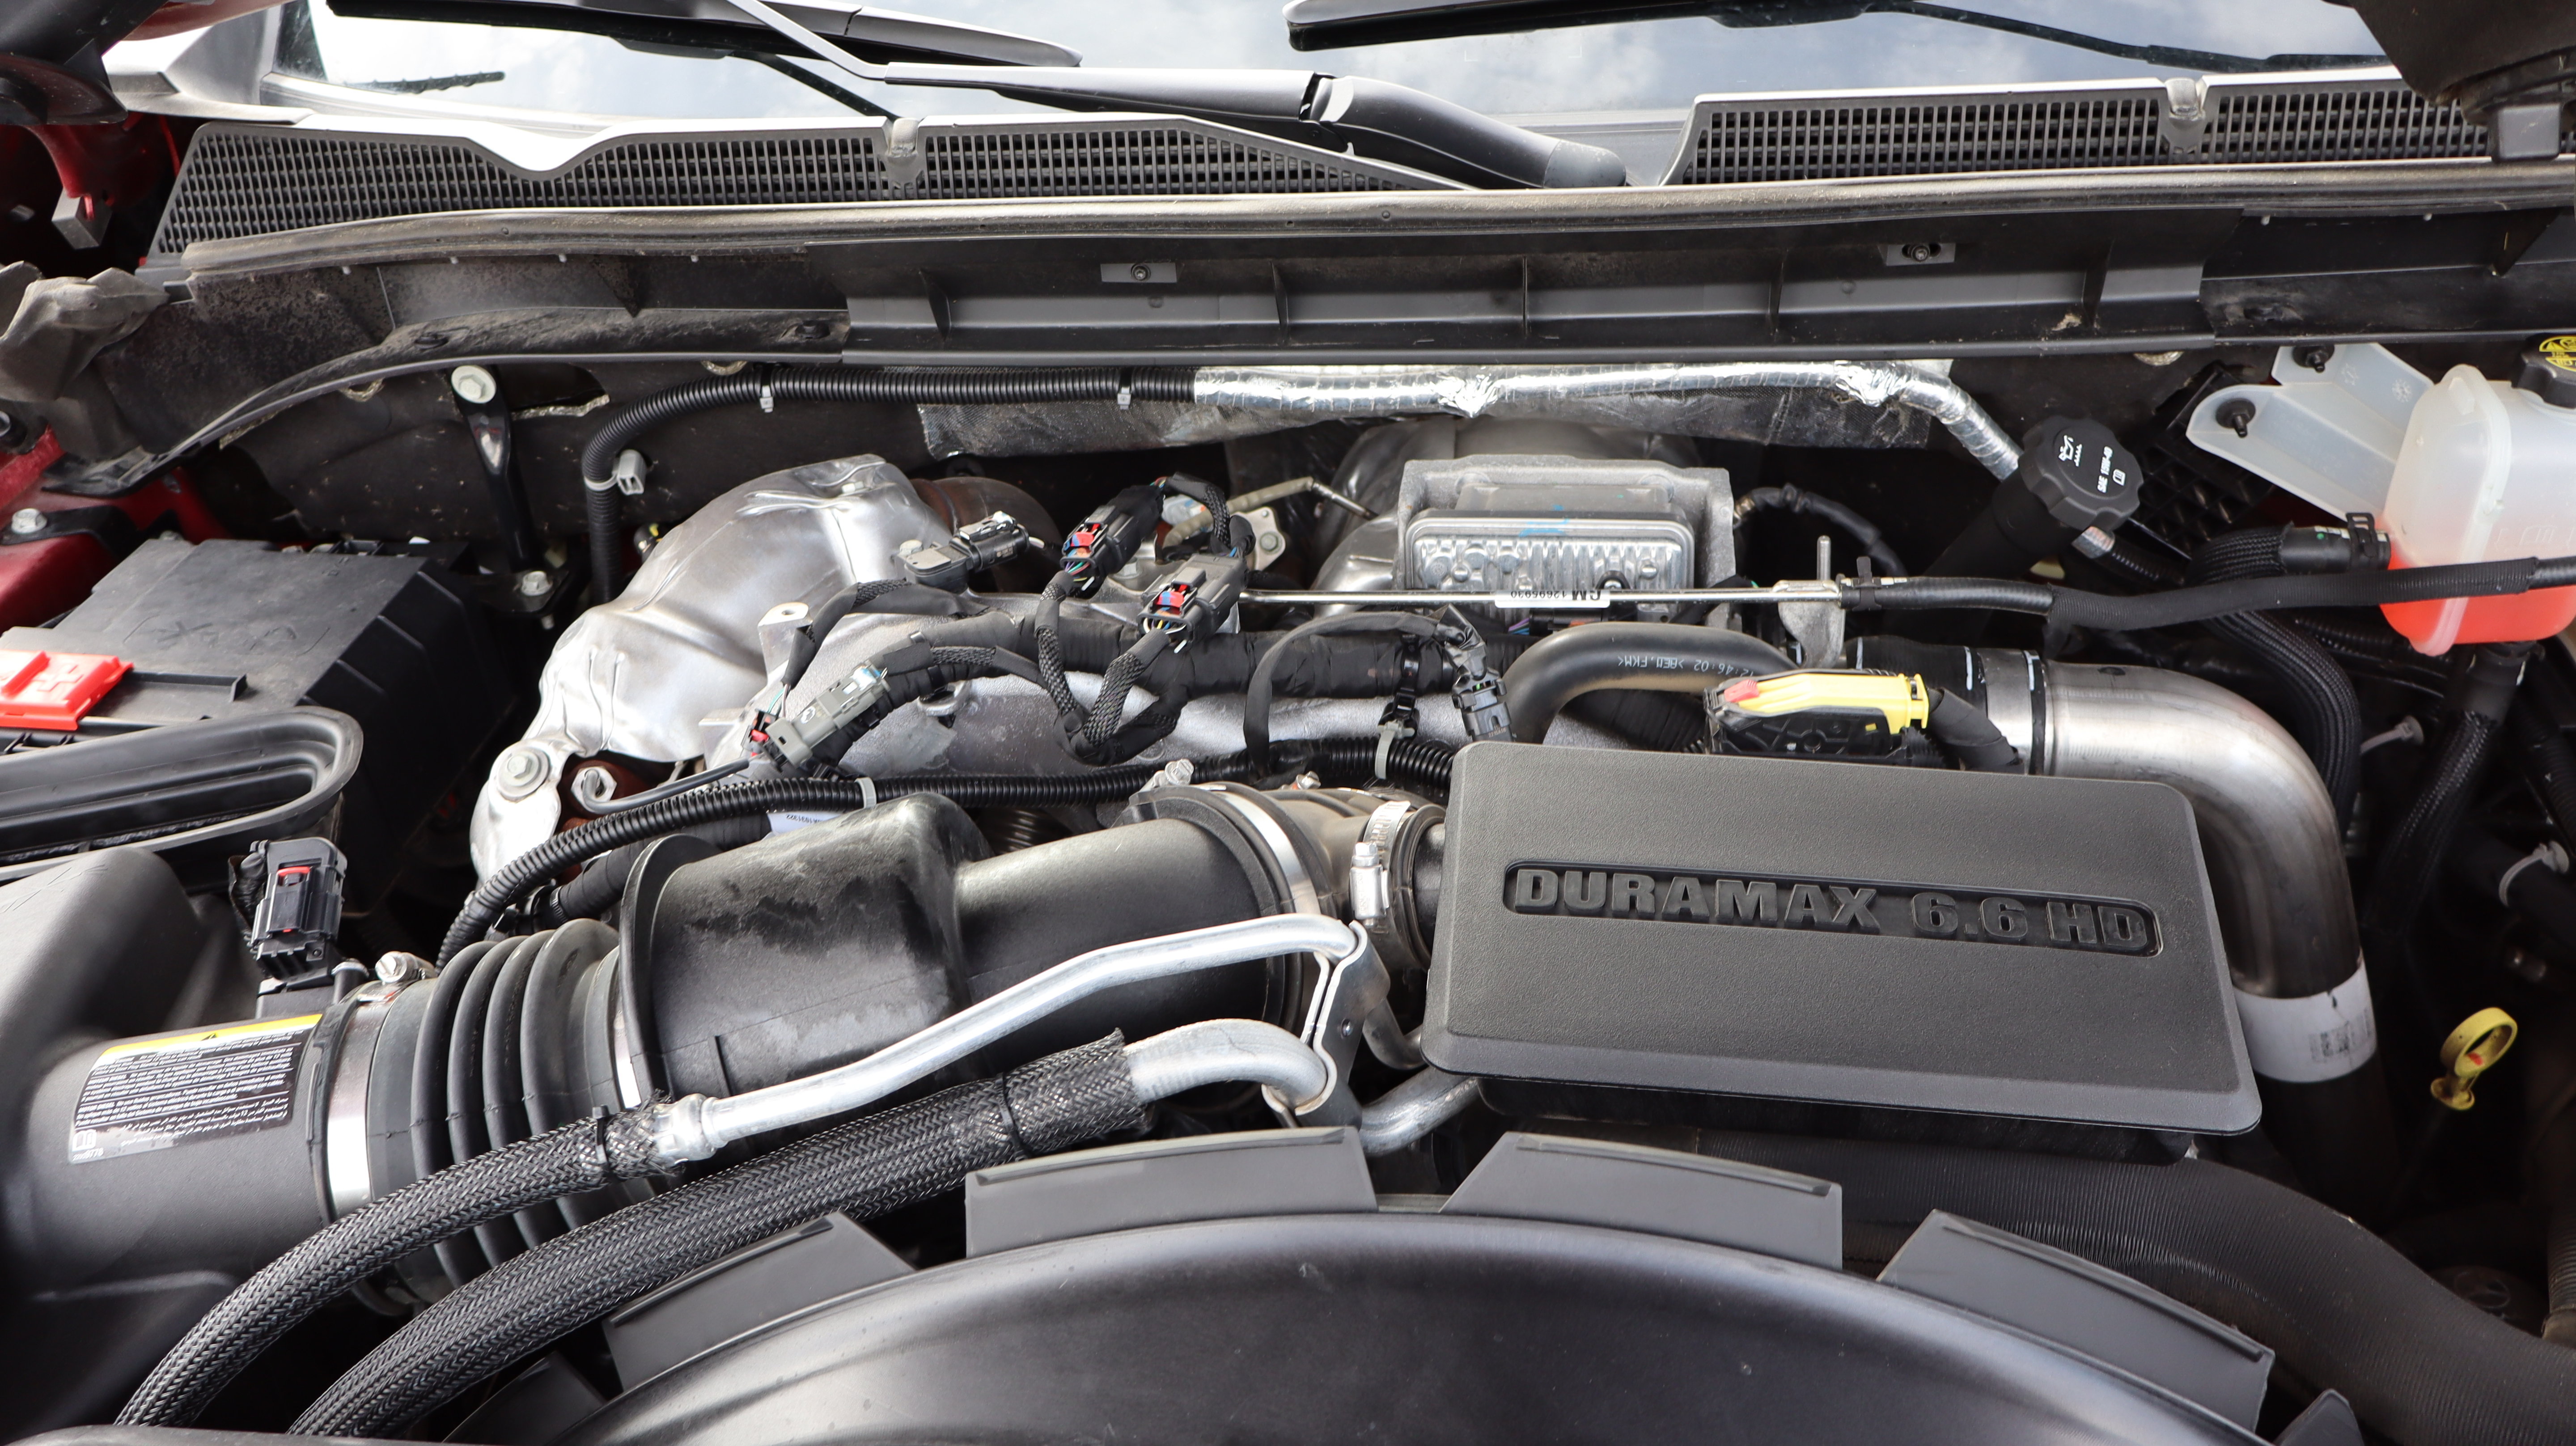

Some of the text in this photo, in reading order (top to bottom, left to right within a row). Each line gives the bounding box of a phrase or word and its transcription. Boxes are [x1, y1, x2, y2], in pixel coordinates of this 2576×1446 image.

[2097, 446, 2113, 493] SAE 15W-40
[1572, 590, 1601, 601] GM
[1515, 869, 2148, 951] DURAMAX 6.6 HD
